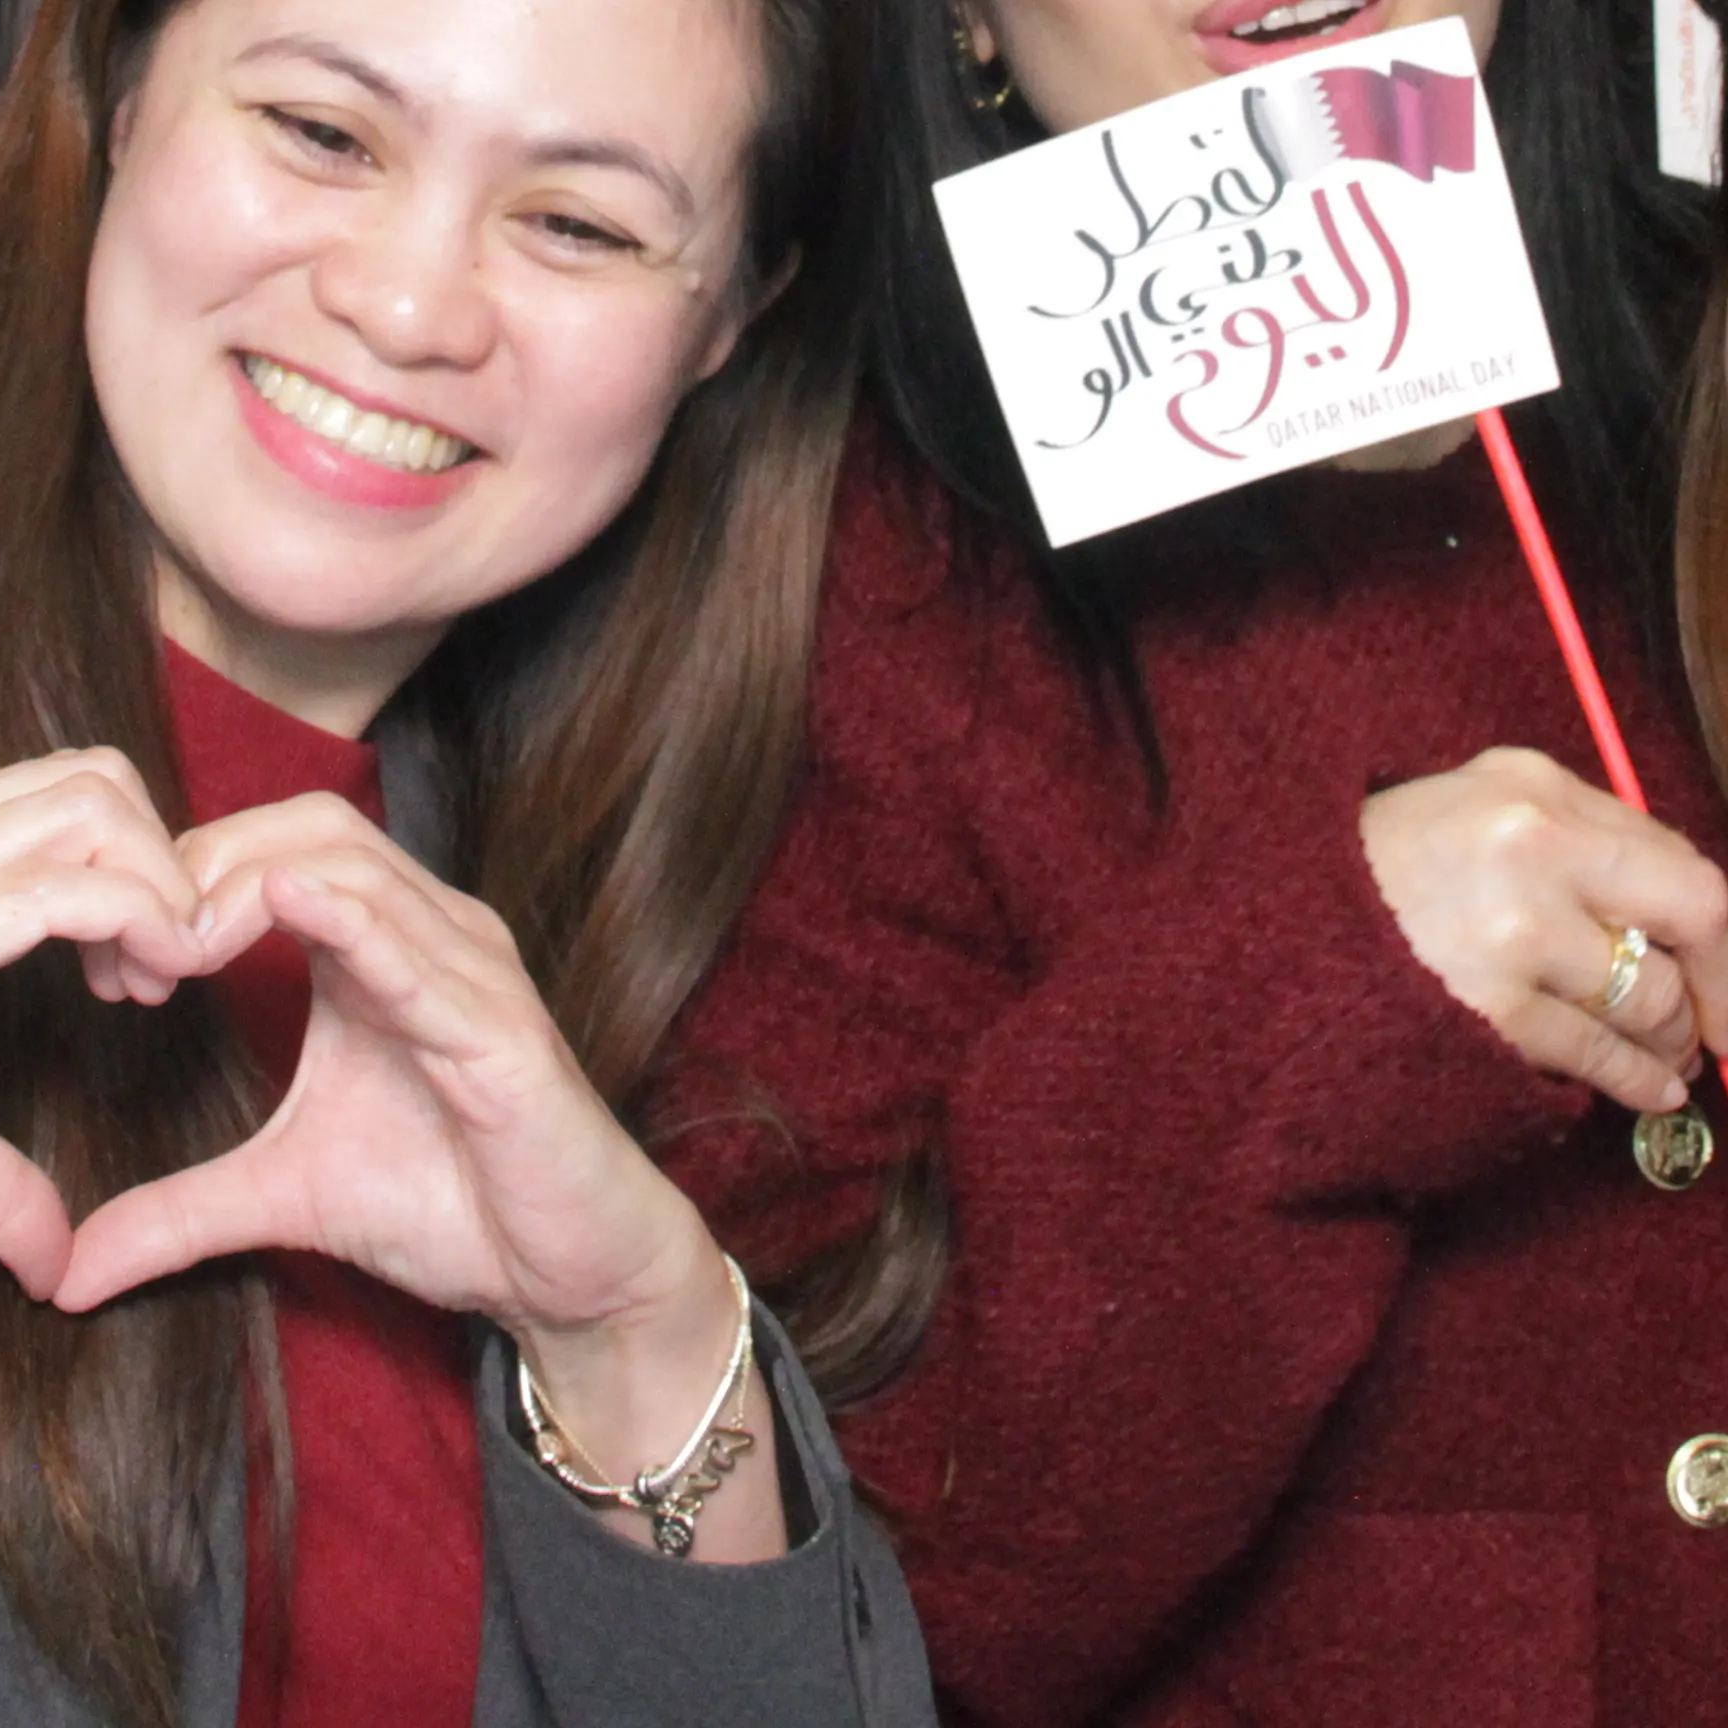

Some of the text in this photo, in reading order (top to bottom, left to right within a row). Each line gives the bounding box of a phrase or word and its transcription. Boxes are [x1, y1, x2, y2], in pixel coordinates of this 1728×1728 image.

[1166, 181, 1411, 460] اليوم
[1266, 351, 1517, 449] QATAR NATIONAL DAY
